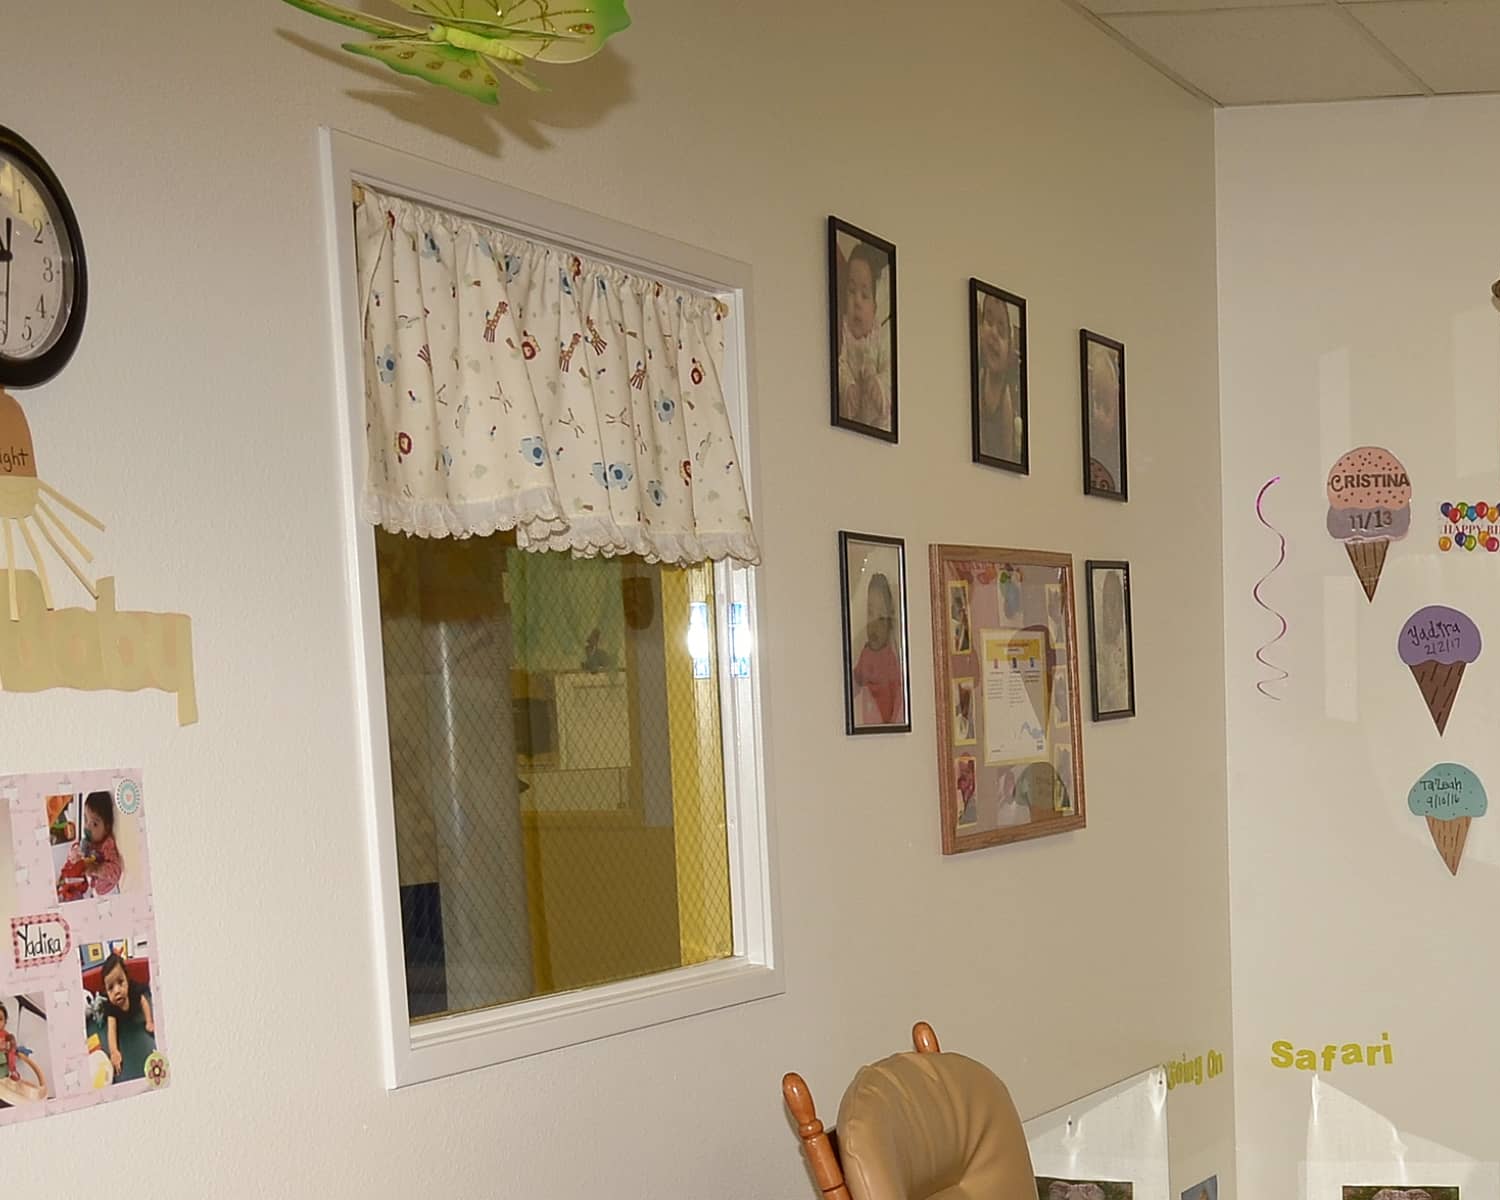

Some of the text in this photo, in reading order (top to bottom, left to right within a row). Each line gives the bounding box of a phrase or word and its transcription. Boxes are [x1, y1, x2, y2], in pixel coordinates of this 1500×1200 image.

[16, 188, 23, 213] 1
[32, 218, 43, 243] 2
[42, 257, 53, 282] 3
[35, 295, 46, 318] 4
[21, 316, 32, 340] 5
[1331, 473, 1409, 492] CRISTINA
[1349, 510, 1393, 530] 11/13
[1407, 620, 1461, 647] Yadira
[1271, 1032, 1393, 1072] Safari
